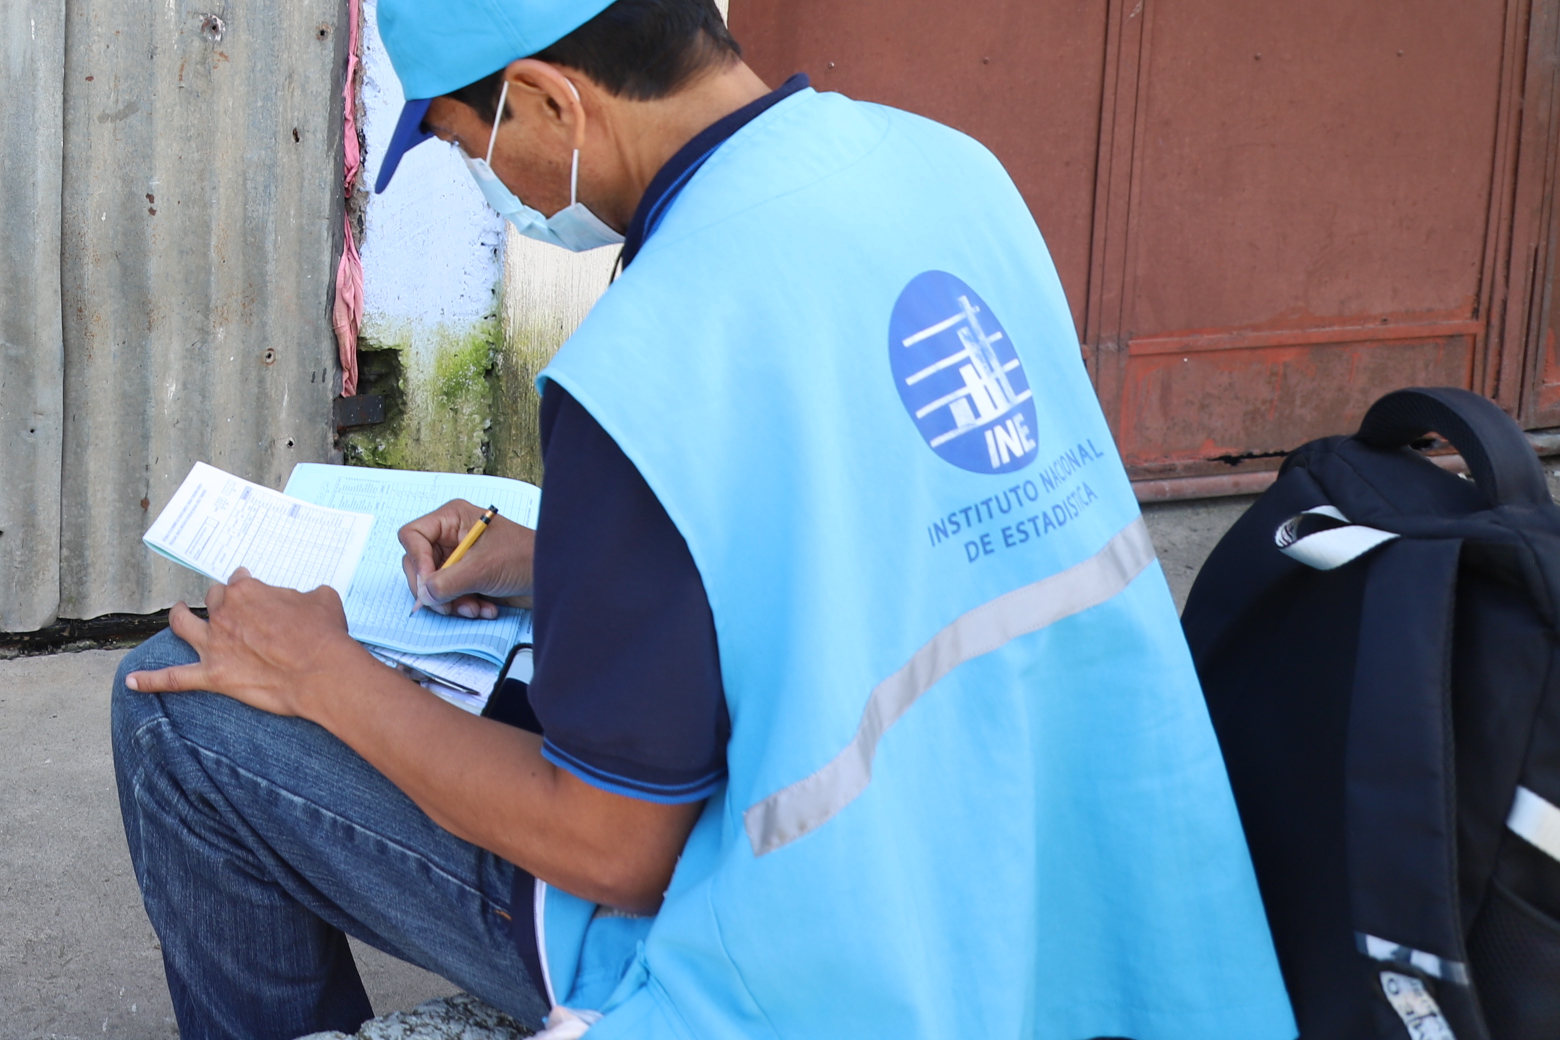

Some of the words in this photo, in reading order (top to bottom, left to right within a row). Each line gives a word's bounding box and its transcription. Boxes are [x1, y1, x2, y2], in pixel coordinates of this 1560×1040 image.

[984, 414, 1036, 468] INE
[928, 480, 1038, 547] INSTITUTO
[1040, 439, 1104, 493] NACIONAL
[964, 533, 994, 562] DE
[1001, 482, 1097, 548] ESTADISTICA
